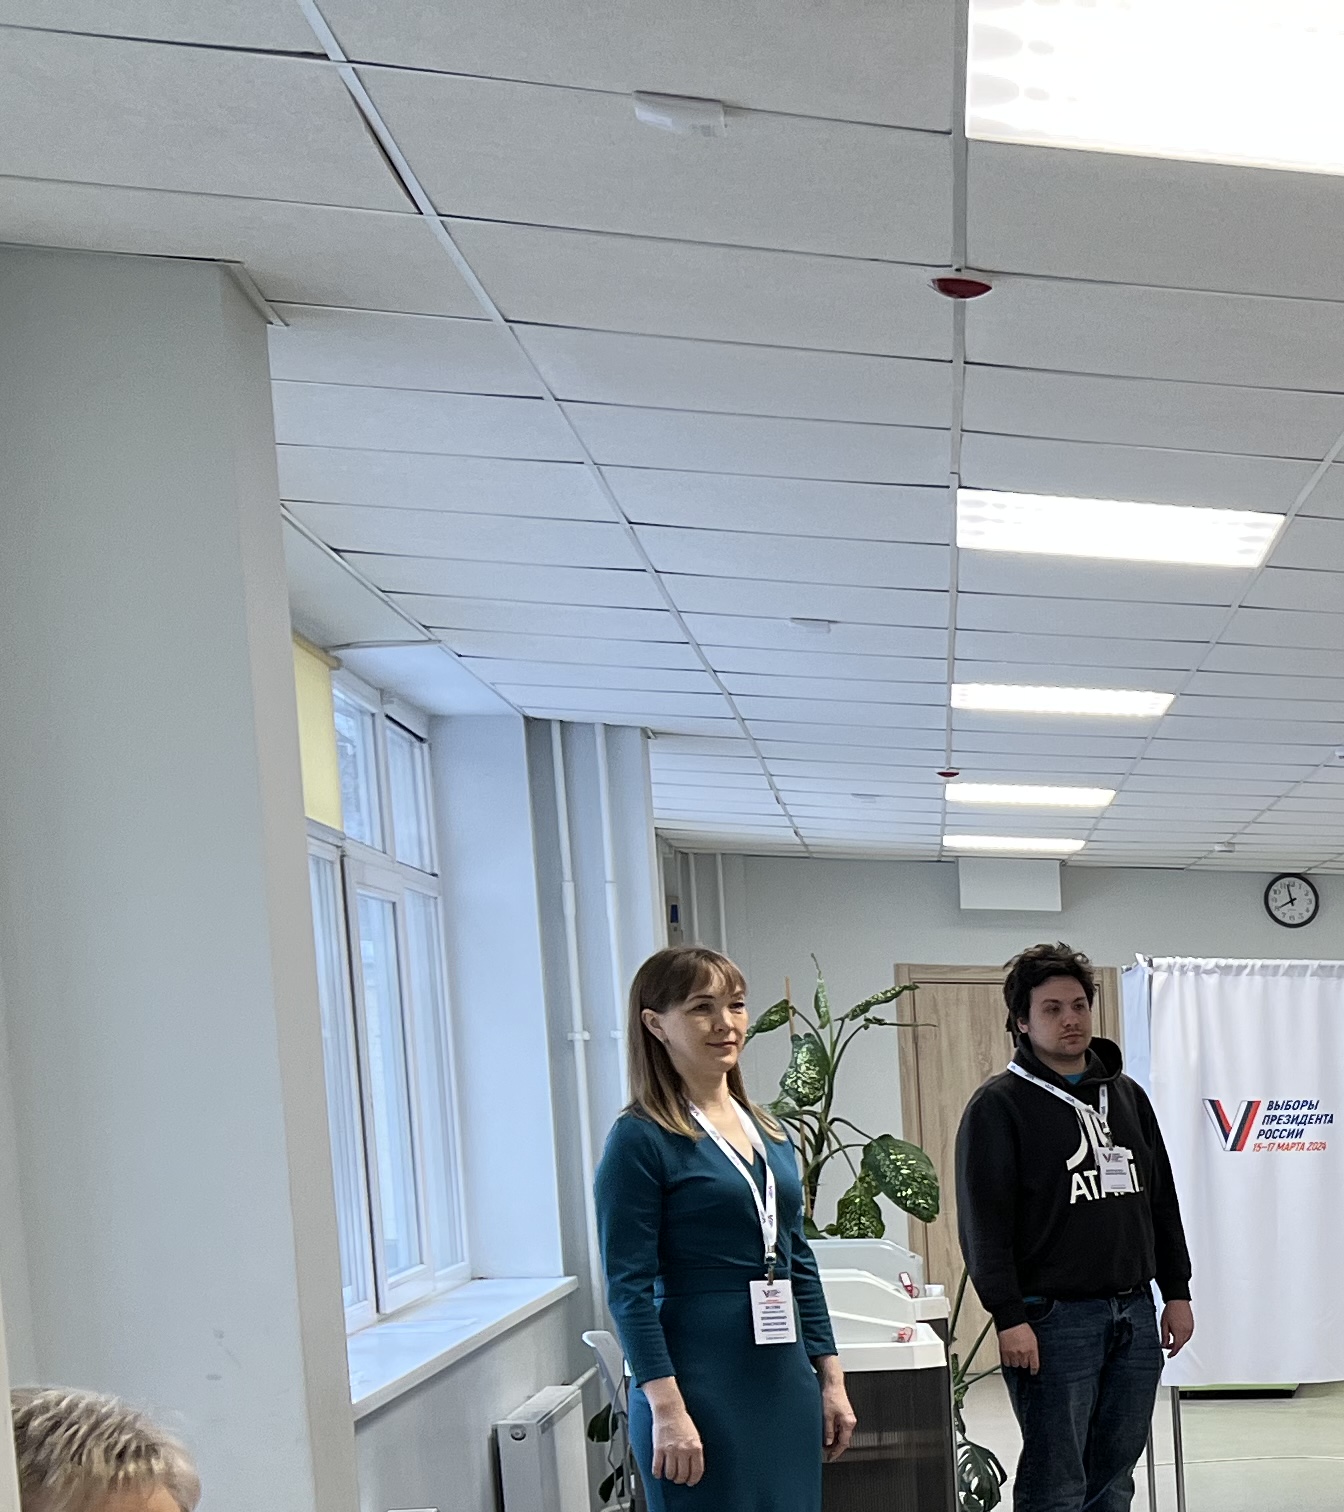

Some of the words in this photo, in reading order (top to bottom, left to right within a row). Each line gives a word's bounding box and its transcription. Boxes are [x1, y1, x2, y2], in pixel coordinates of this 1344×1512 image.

[1266, 1100, 1320, 1111] ВЫБОРЫ
[1262, 1113, 1334, 1126] ПРЕЗИДЕНТА
[1257, 1128, 1305, 1140] РОССИИ
[1276, 1142, 1305, 1152] МАРТА
[1306, 1141, 1327, 1151] 2024
[1070, 1163, 1140, 1204] ATI
